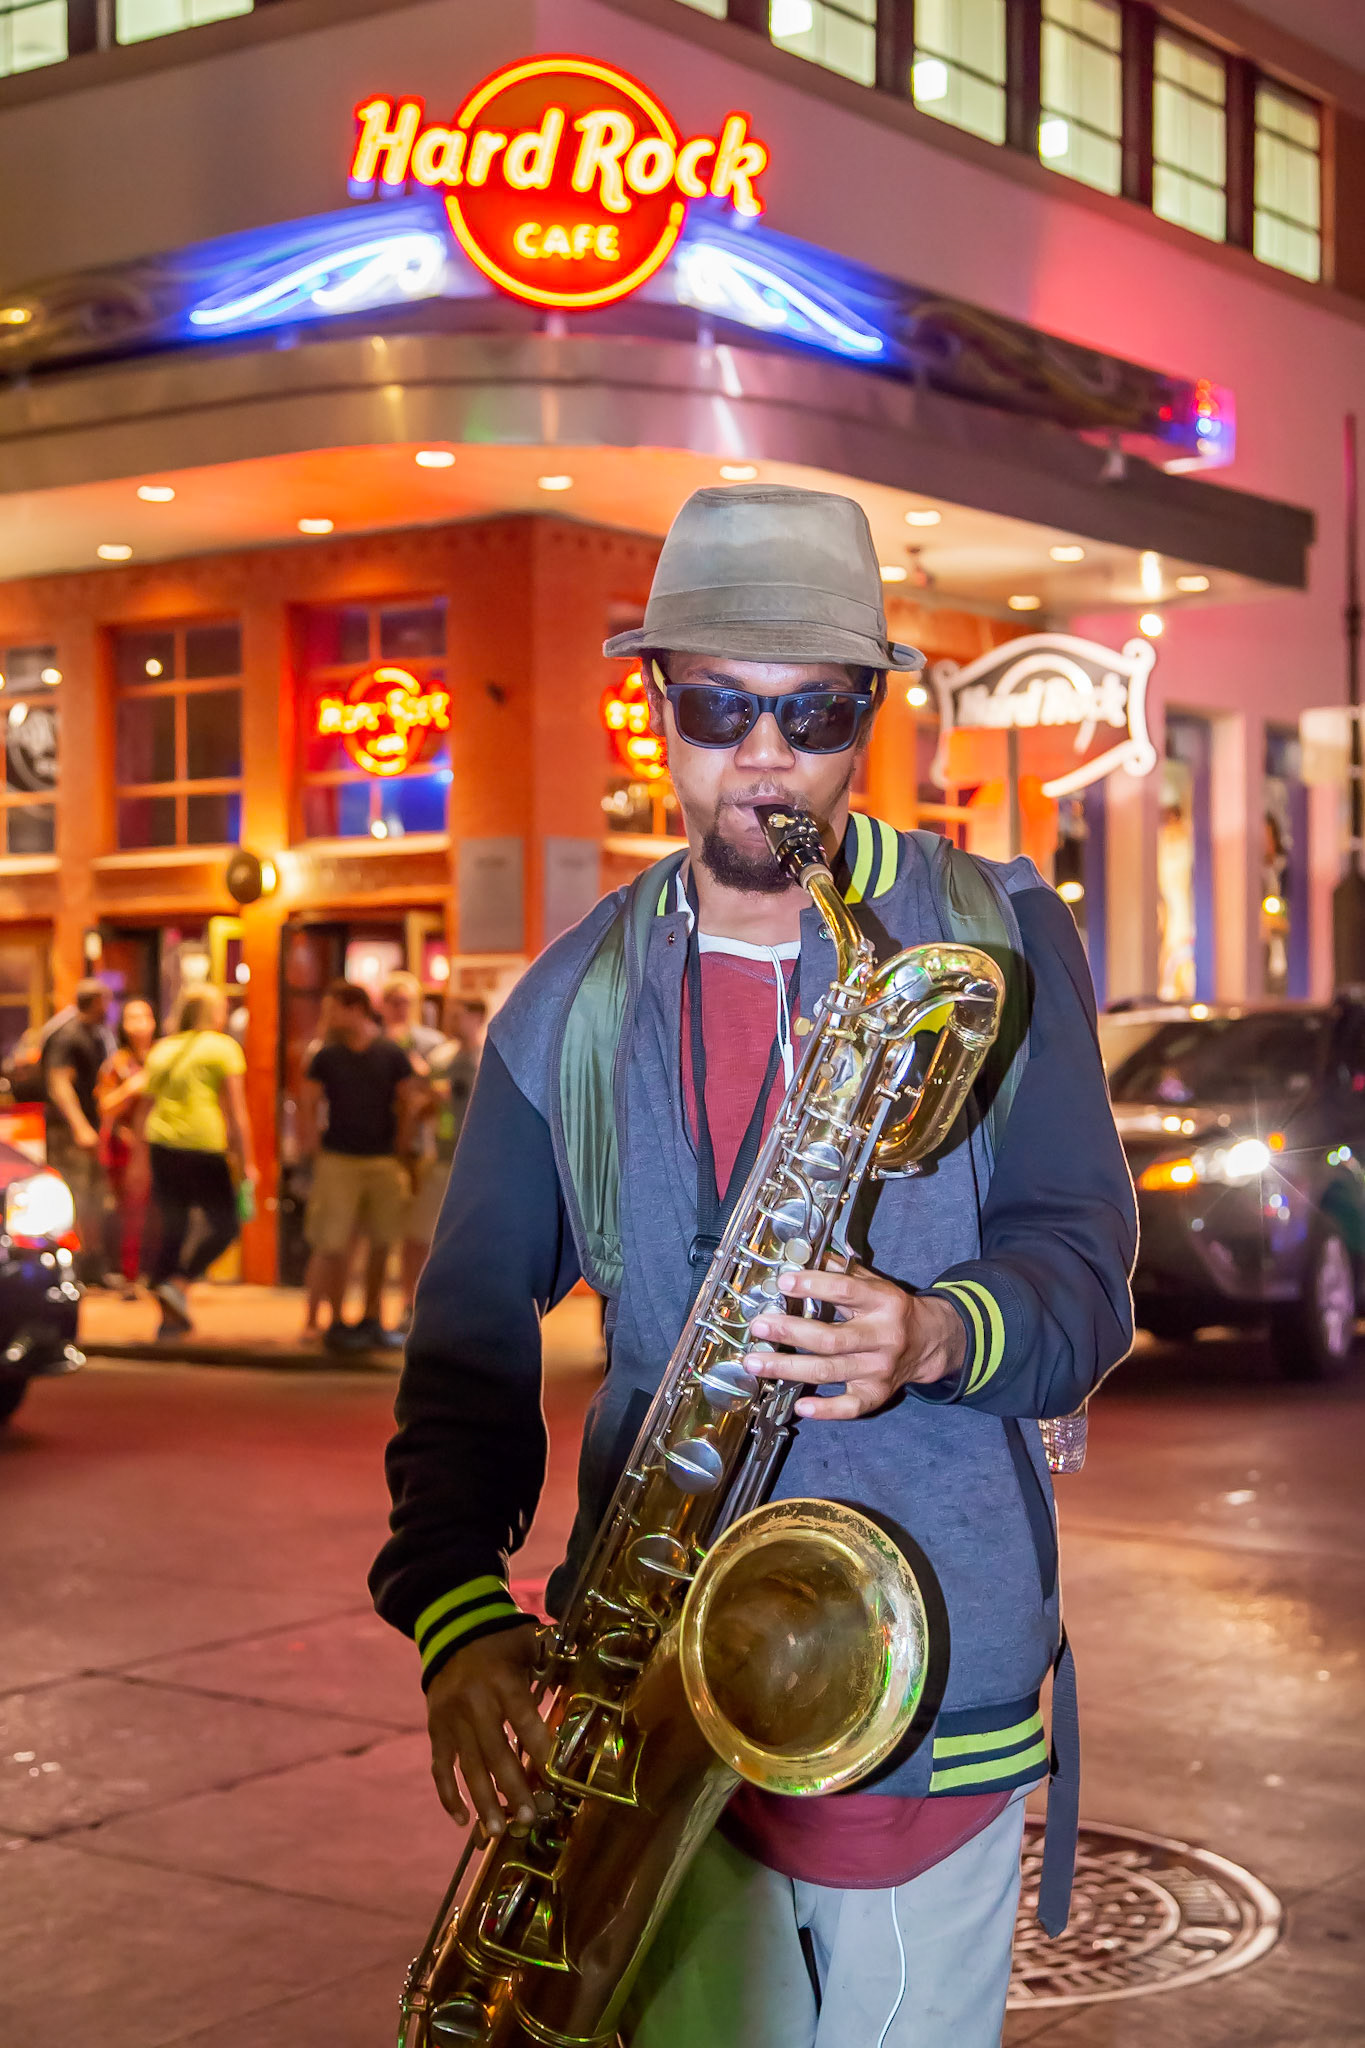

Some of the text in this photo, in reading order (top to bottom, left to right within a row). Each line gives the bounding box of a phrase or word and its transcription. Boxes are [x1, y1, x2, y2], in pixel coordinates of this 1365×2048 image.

[352, 98, 768, 217] Hard Rock
[512, 221, 621, 262] CAFE
